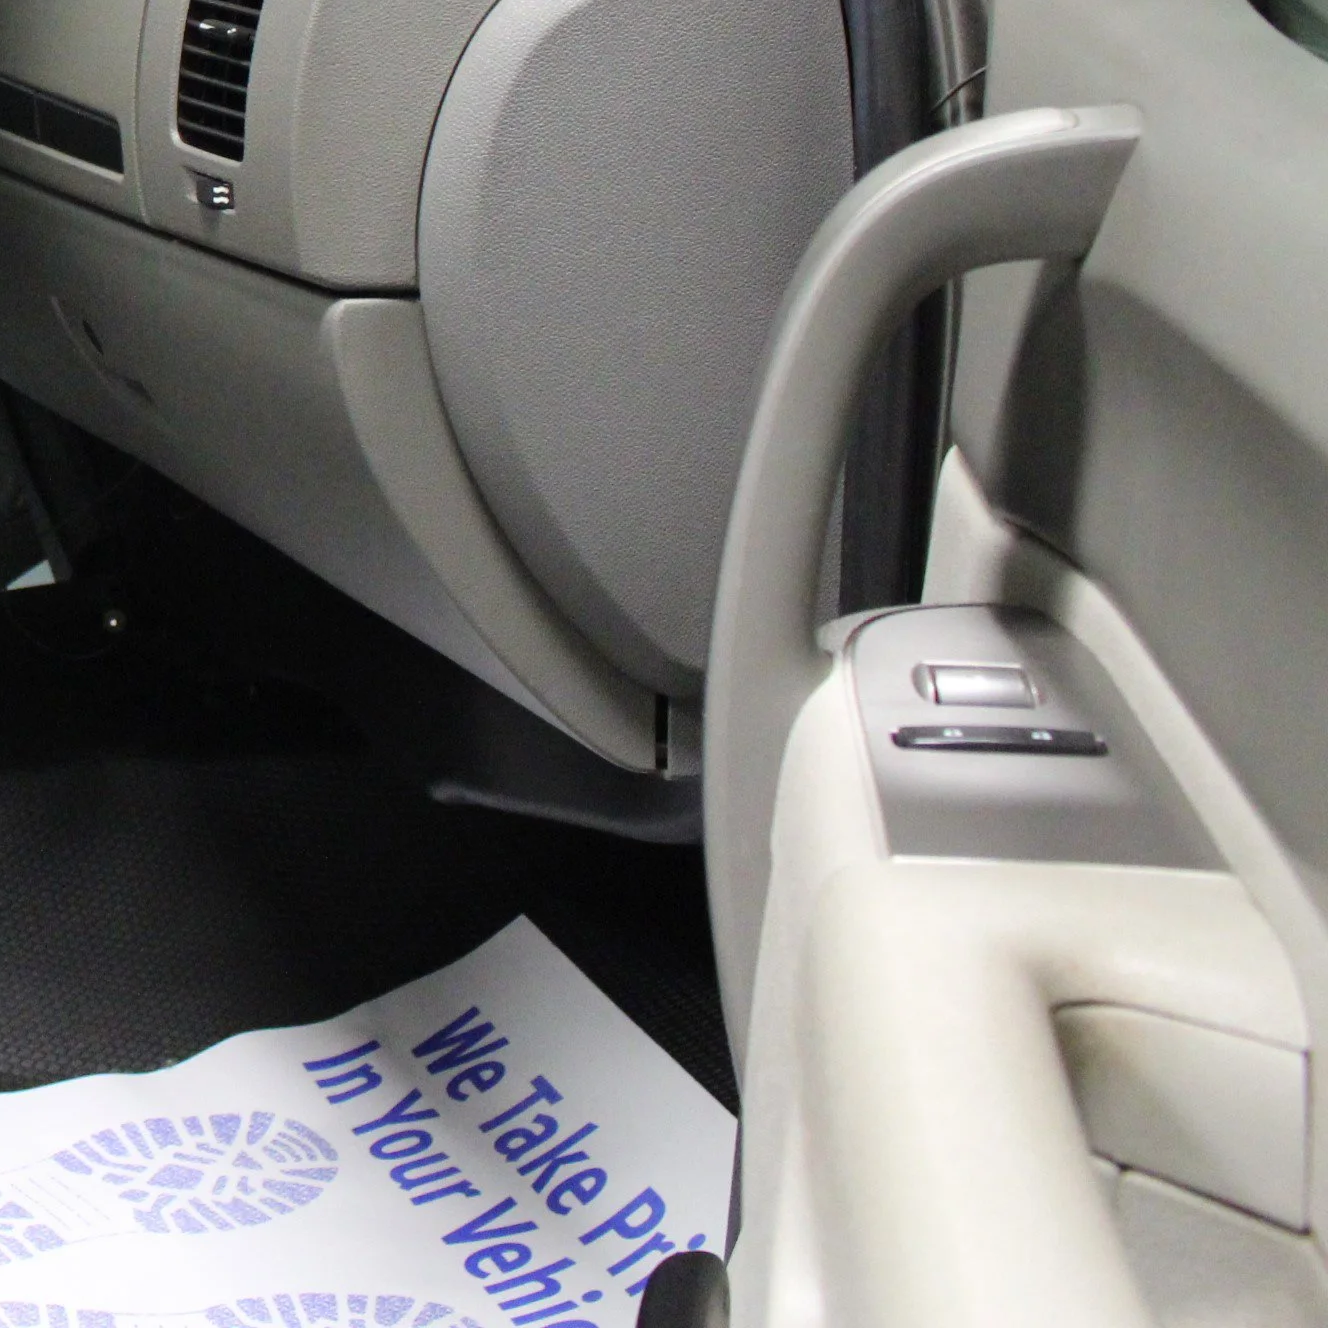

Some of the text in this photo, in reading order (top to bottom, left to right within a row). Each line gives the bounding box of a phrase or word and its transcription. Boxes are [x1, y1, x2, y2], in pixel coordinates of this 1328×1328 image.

[302, 1039, 603, 1328] In Your Vehi
[412, 1006, 509, 1101] We
[478, 1075, 608, 1215] Take
